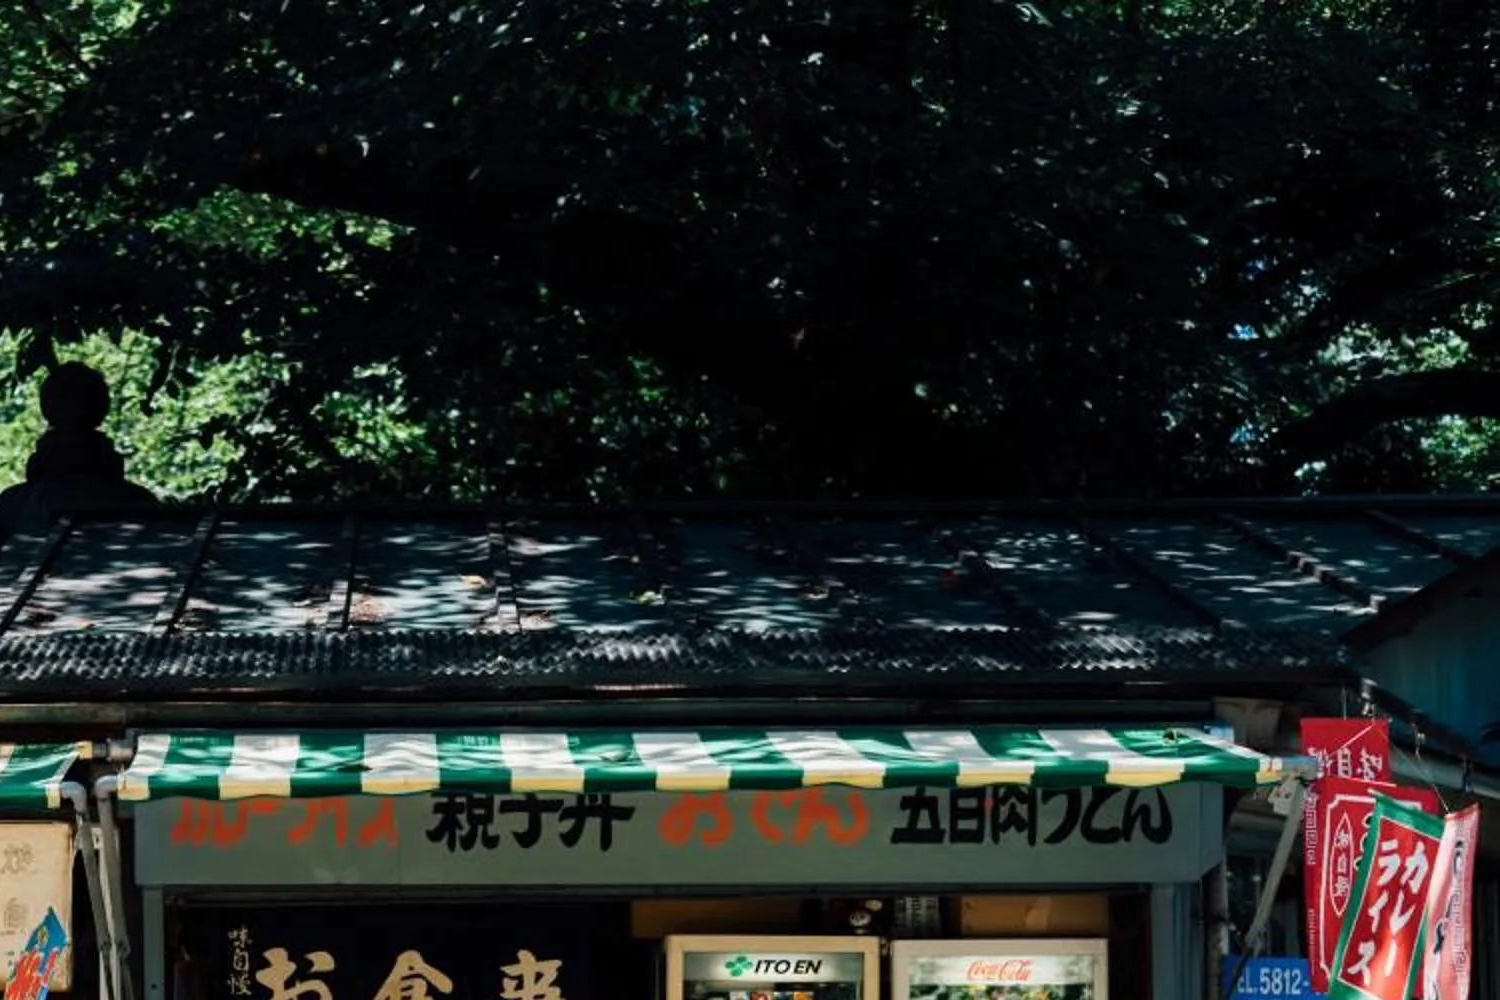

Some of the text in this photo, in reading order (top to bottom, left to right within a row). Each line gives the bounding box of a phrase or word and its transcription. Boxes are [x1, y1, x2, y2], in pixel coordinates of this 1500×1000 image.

[1348, 839, 1400, 986] ライス
[1385, 841, 1430, 976] カレー
[227, 927, 253, 996] 味自慢
[754, 959, 823, 975] ITO EN
